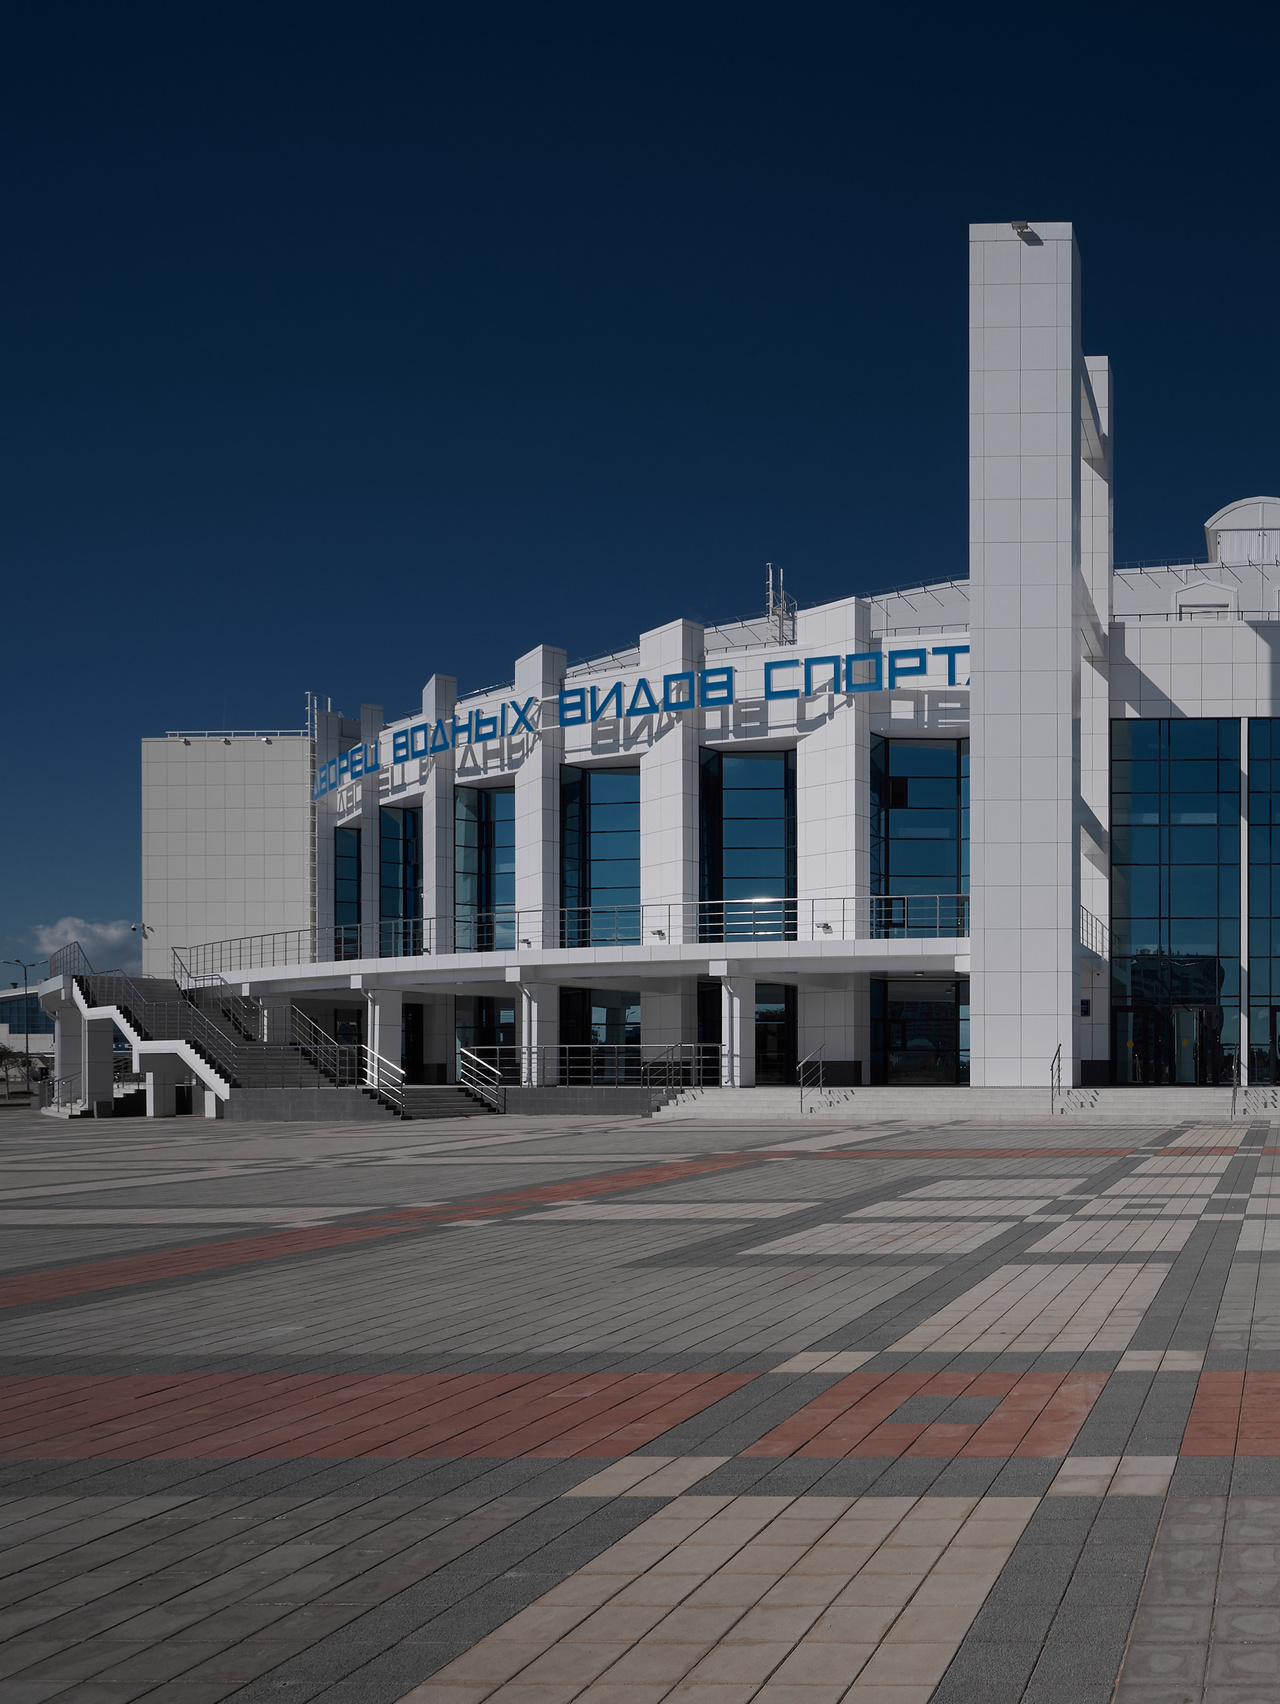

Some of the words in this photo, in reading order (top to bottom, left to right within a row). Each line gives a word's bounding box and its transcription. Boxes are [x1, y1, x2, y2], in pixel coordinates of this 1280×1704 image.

[312, 739, 381, 802] ДВОРЕЦ
[393, 696, 536, 764] ВОДНЫХ
[559, 666, 735, 727] ВИДОВ
[764, 645, 970, 700] СПОРТ
